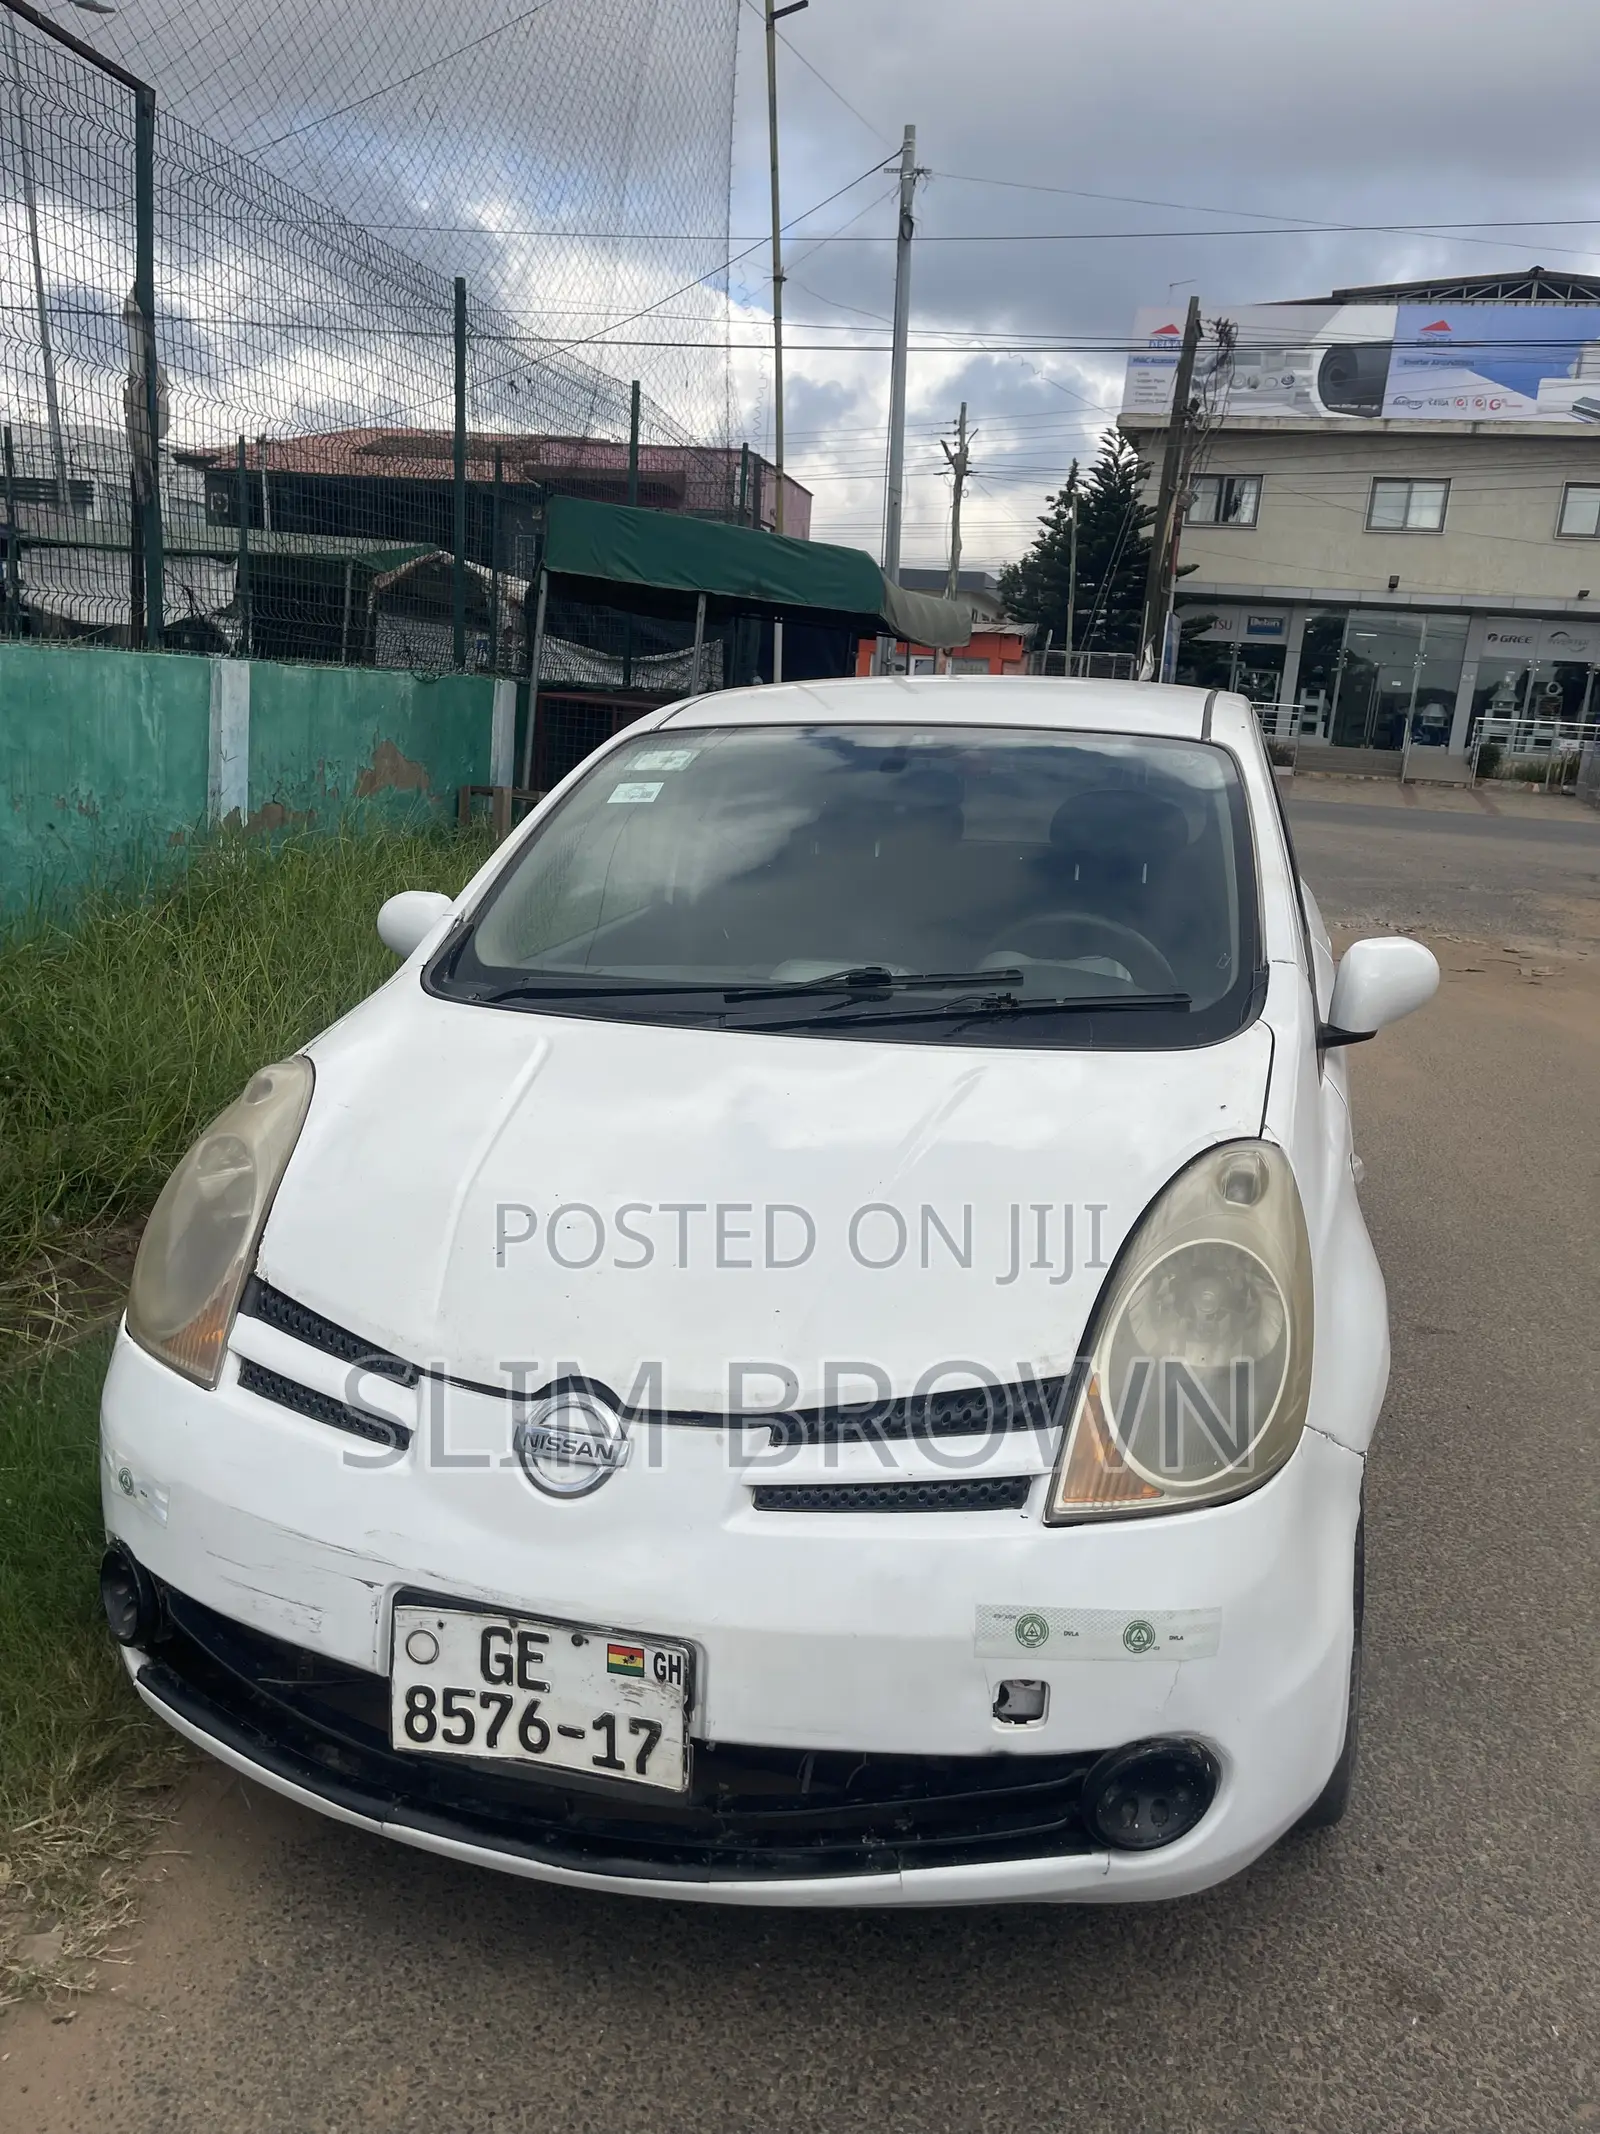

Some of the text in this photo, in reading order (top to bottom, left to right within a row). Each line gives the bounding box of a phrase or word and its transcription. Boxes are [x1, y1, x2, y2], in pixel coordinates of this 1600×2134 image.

[1500, 634, 1533, 645] GREE
[522, 1431, 615, 1461] NISSAN
[480, 1624, 551, 1693] GE
[652, 1651, 682, 1686] GH
[404, 1684, 663, 1775] 8576-17
